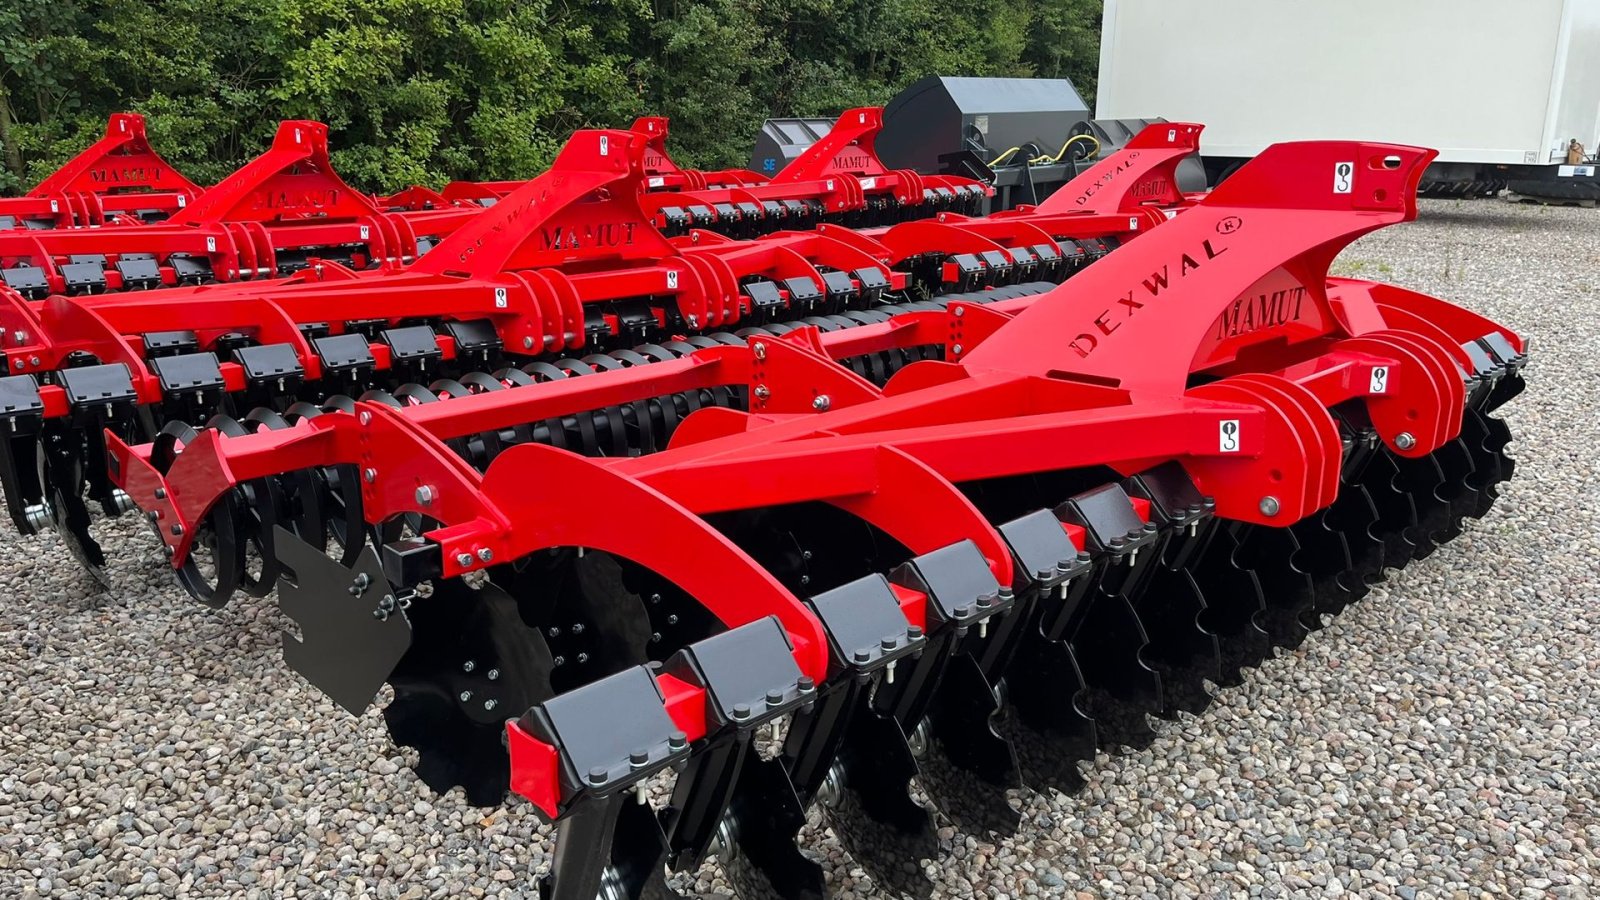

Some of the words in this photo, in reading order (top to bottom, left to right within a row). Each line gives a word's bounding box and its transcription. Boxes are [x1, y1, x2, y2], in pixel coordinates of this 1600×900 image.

[763, 159, 776, 170] SE
[832, 155, 871, 169] MAMUT
[538, 222, 638, 252] MAMUT
[1216, 286, 1307, 341] MAMUT
